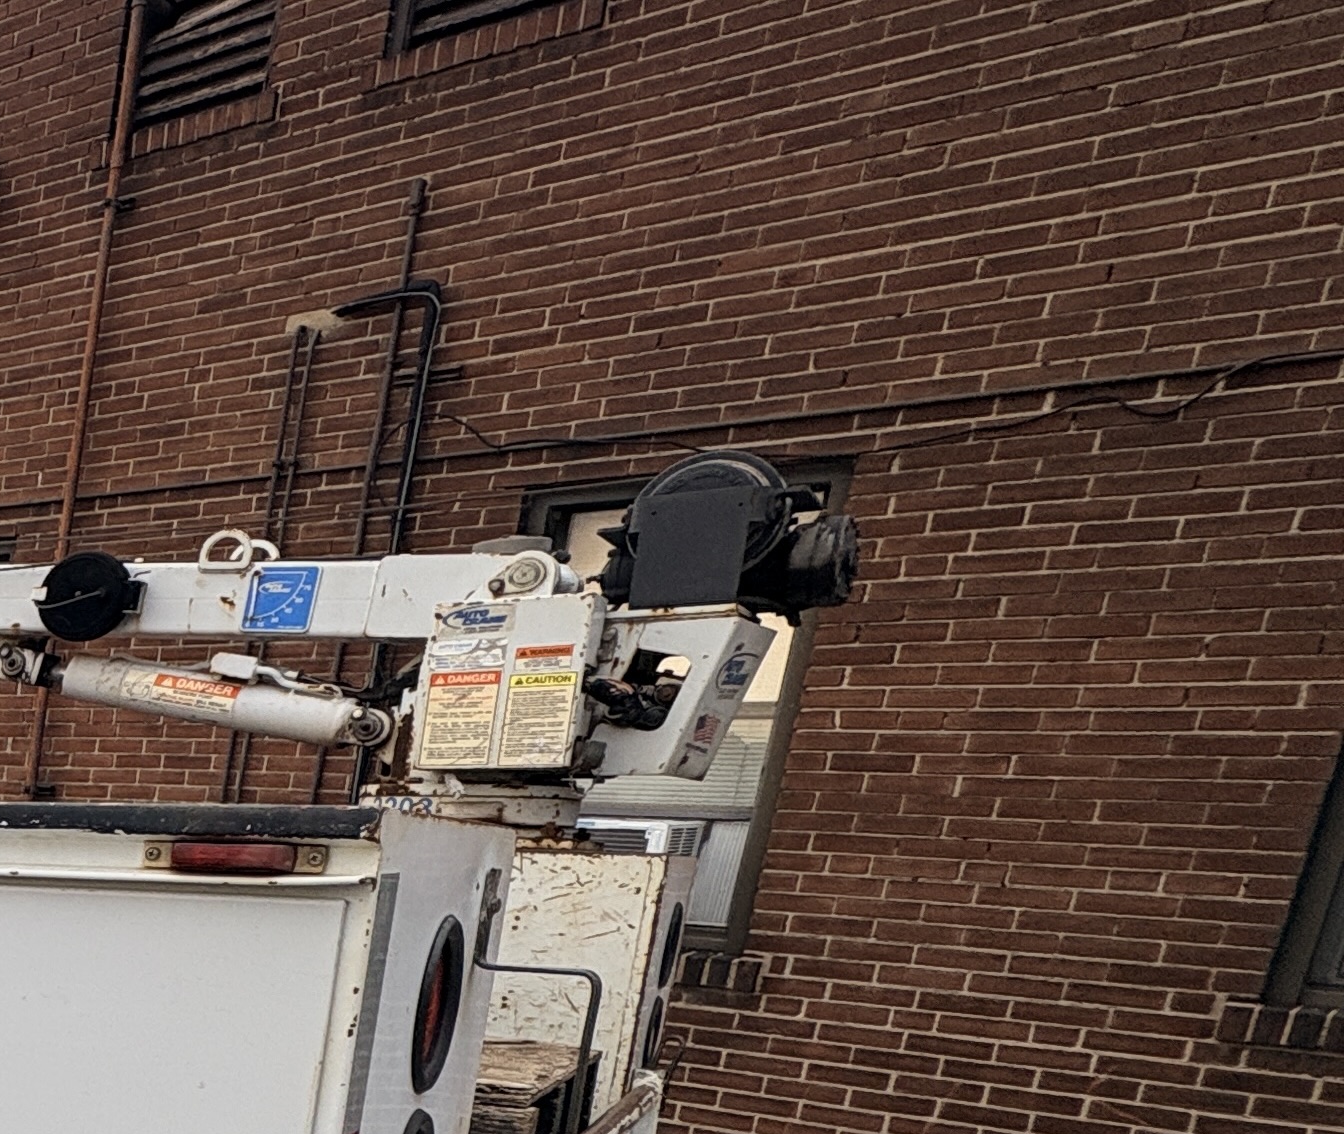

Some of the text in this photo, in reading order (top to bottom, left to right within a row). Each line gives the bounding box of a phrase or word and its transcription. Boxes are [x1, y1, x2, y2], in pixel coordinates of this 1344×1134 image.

[453, 609, 490, 620] AUTO
[447, 673, 496, 683] DANGER
[525, 675, 572, 685] CAUTION
[175, 679, 234, 697] DANGER
